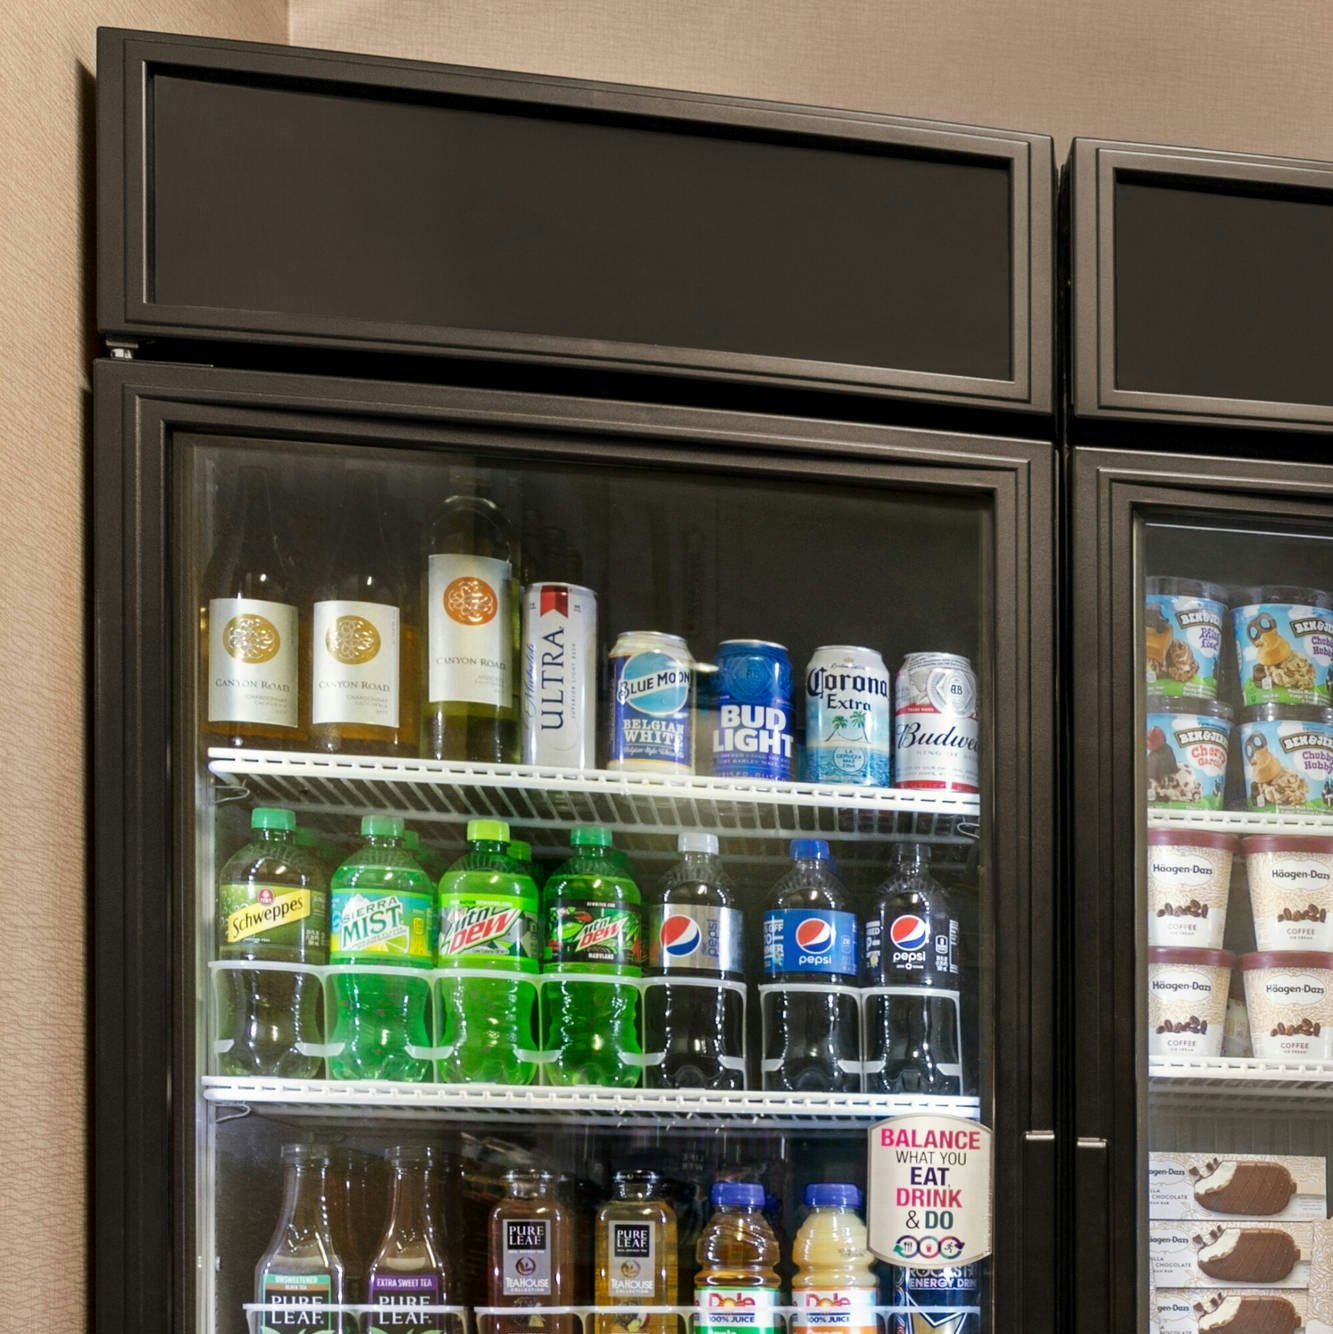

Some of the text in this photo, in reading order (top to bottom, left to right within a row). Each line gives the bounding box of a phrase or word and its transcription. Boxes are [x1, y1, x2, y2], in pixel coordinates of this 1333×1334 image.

[540, 626, 566, 731] ULTRA
[616, 669, 691, 701] BLUE MOON
[807, 667, 888, 699] Corona
[827, 693, 872, 711] Extra
[719, 704, 787, 730] BUD
[622, 719, 684, 734] BELGIAN
[622, 731, 685, 749] WHITE
[712, 728, 795, 758] LIGHT
[232, 896, 304, 937] Schweppes
[342, 905, 402, 947] MIST
[1168, 923, 1197, 931] COFFEE
[799, 954, 832, 966] pepsi
[893, 950, 926, 963] pepsi
[1168, 1040, 1196, 1048] COFFEE
[880, 1127, 981, 1150] BALANCE
[895, 1150, 967, 1166] WHAT YOU
[896, 1188, 962, 1209] DRINK
[905, 1210, 954, 1230] & DO
[509, 1225, 544, 1236] PURE
[616, 1229, 648, 1240] PURE
[509, 1235, 542, 1247] LEAF
[616, 1239, 649, 1250] LEAF
[708, 1293, 756, 1307] Dole
[805, 1293, 851, 1307] Dole
[708, 1313, 755, 1324] 100% JUICE
